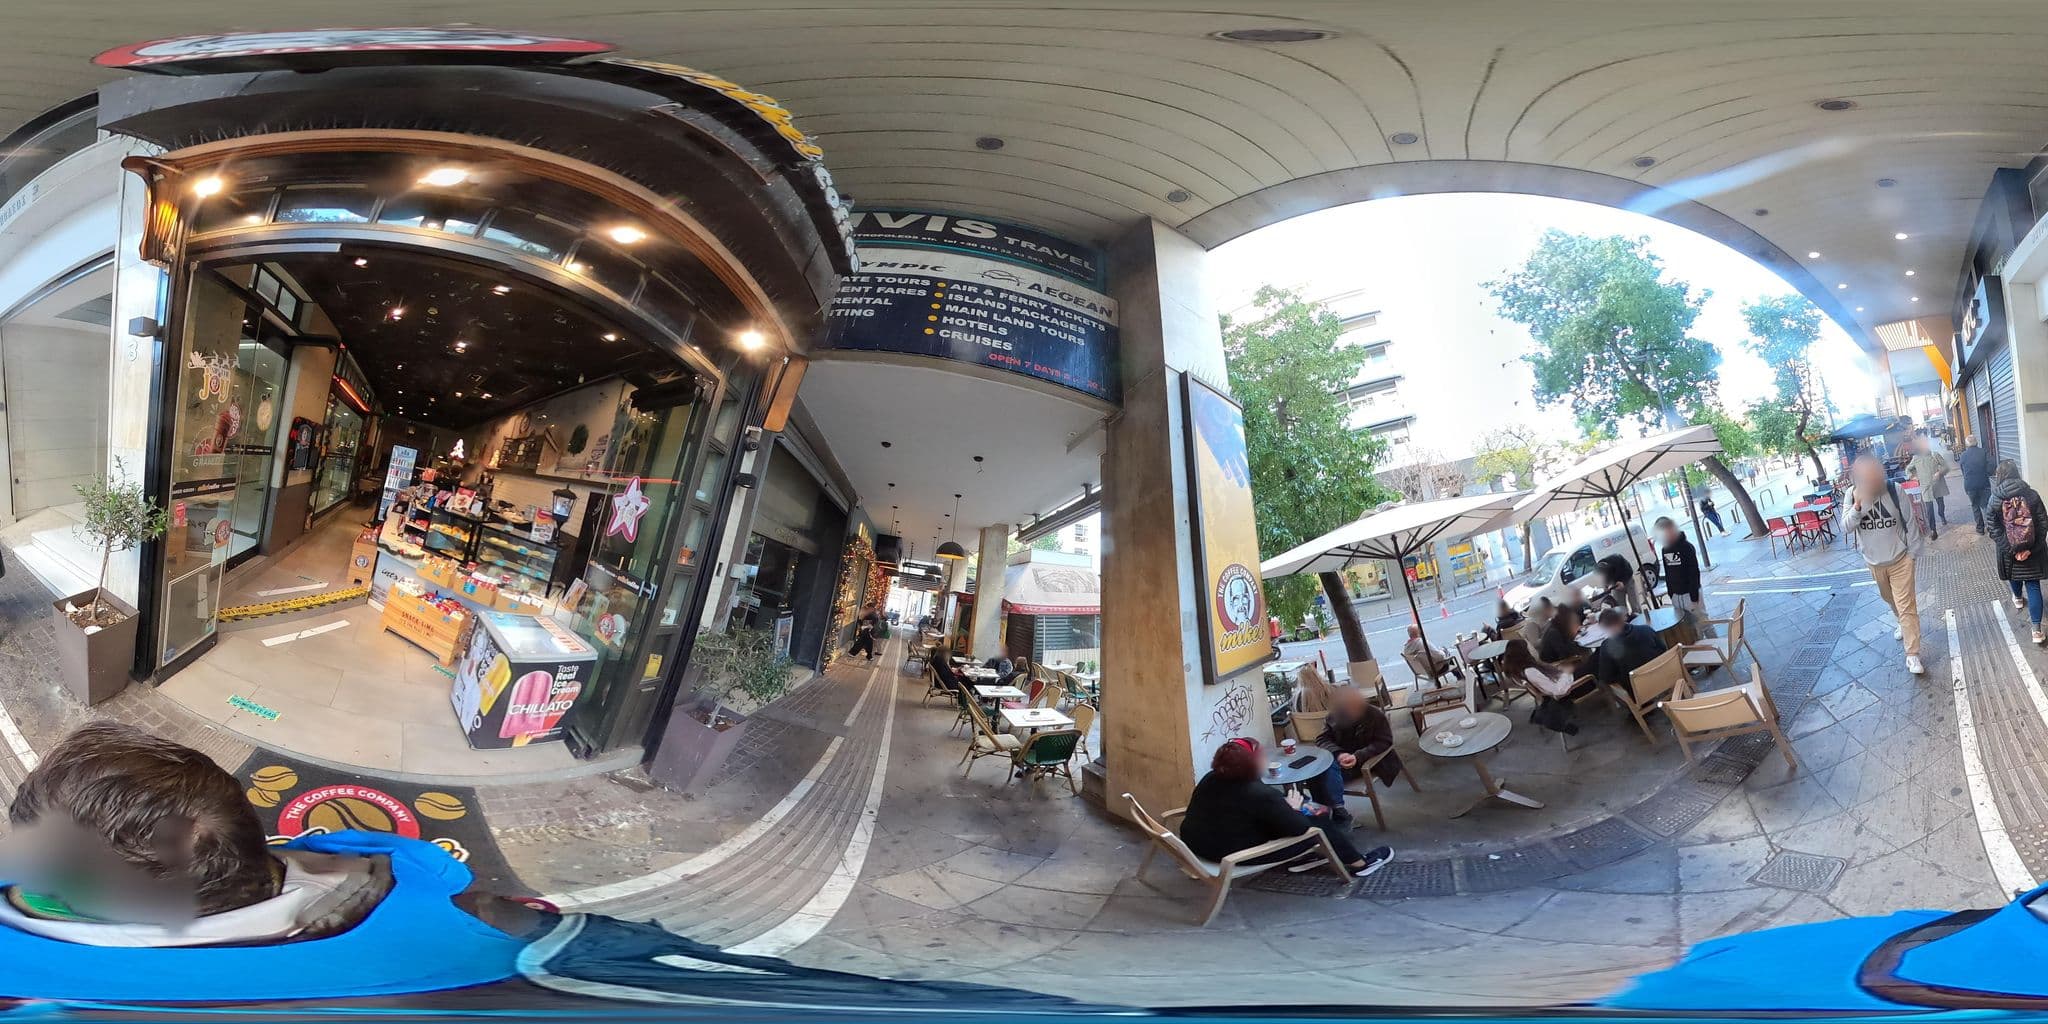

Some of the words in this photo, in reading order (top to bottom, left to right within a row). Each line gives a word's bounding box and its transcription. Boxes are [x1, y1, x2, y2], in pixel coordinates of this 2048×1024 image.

[1003, 236, 1096, 272] TRAVEL
[875, 276, 932, 287] TOURS
[876, 286, 928, 296] FARES
[950, 282, 979, 293] AIR
[983, 287, 995, 297] &
[998, 291, 1048, 310] FERRY
[1051, 305, 1107, 332] TICKETS
[1028, 282, 1113, 318] AEGEAN
[948, 293, 1008, 310] ISLAND
[1011, 305, 1087, 335] PACKAGES
[942, 316, 1009, 336] HOTELS
[945, 304, 988, 318] MAIN
[993, 312, 1036, 330] LAND
[1039, 324, 1086, 347] TOURS
[938, 329, 1014, 351] CRUISES
[988, 352, 1021, 367] OPEN
[1024, 360, 1032, 368] 7
[1034, 363, 1061, 378] DAYS
[1860, 516, 1897, 530] adidas
[1217, 582, 1226, 598] THE
[1222, 566, 1240, 583] COFFEE
[1240, 567, 1259, 595] COMPANY
[556, 671, 577, 681] Real
[558, 665, 579, 673] Taste
[551, 687, 579, 695] Cream
[553, 680, 568, 688] Ice
[509, 700, 574, 715] CHILLATO
[286, 802, 308, 820] THE
[306, 787, 355, 804] COFFEE
[357, 789, 412, 824] COMPANY
